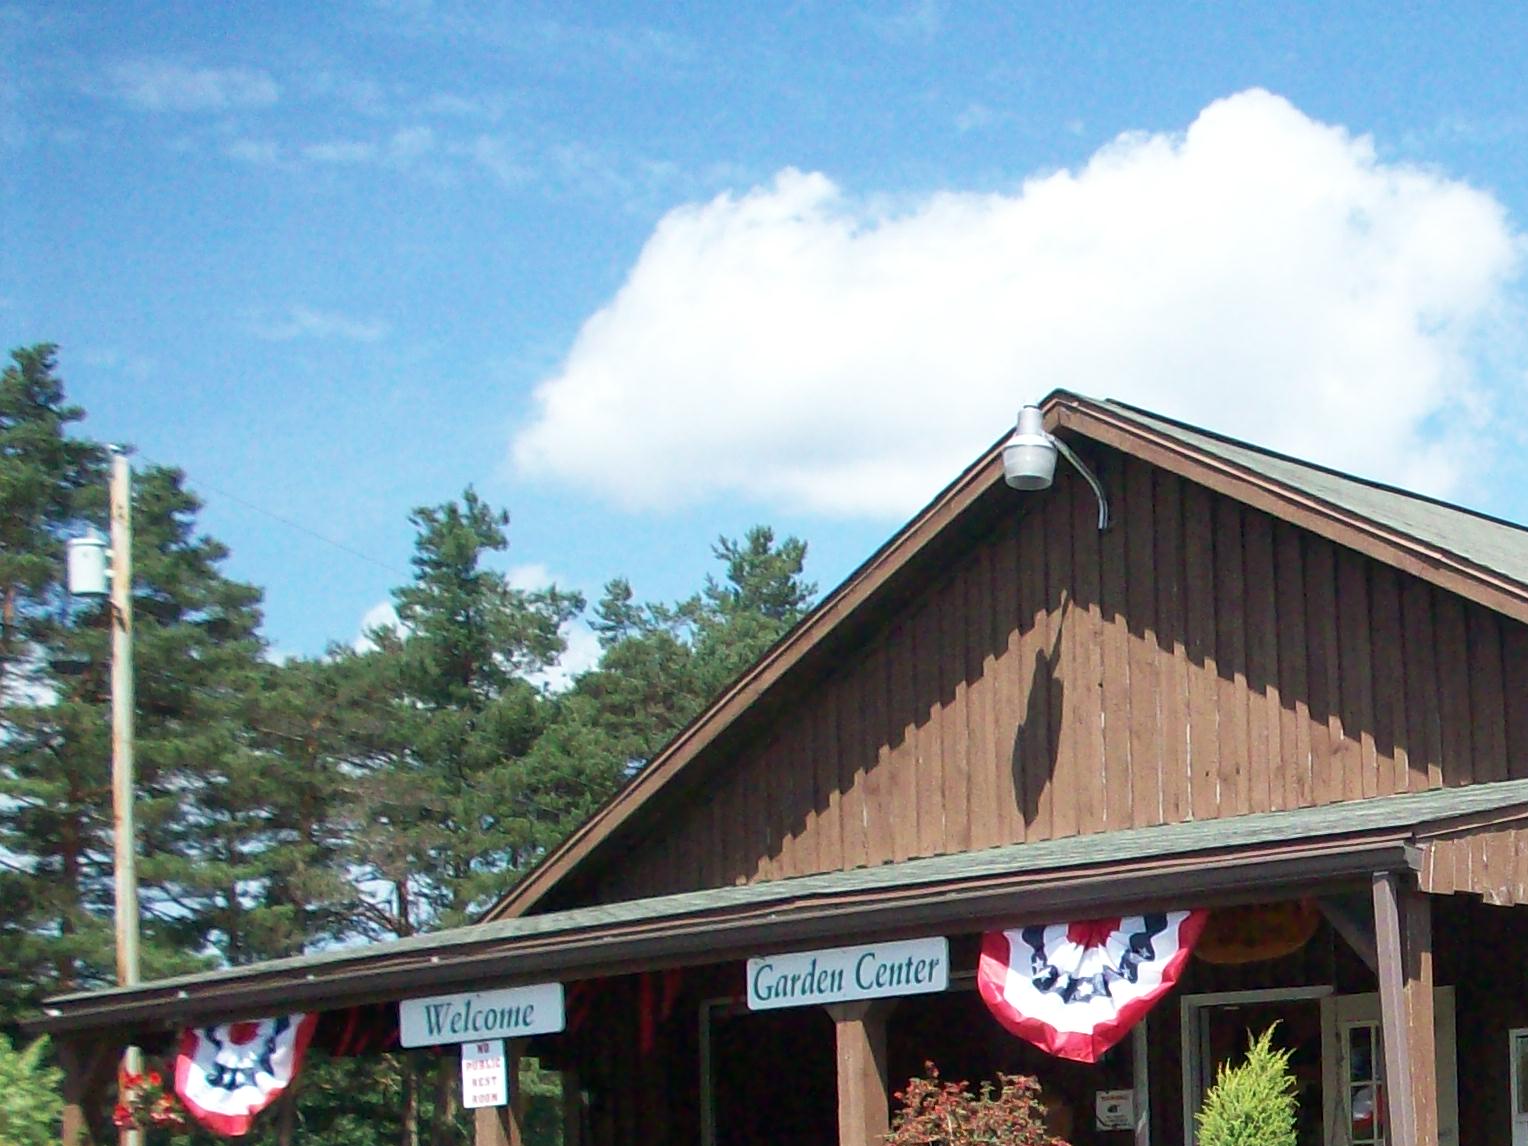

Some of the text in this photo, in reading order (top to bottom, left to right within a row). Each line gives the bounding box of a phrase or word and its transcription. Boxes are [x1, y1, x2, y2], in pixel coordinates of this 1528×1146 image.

[753, 952, 940, 1001] Garden Center
[424, 999, 535, 1037] Welcome
[476, 1042, 490, 1054] NO
[465, 1057, 501, 1071] PUBLIC
[472, 1075, 497, 1087] REST
